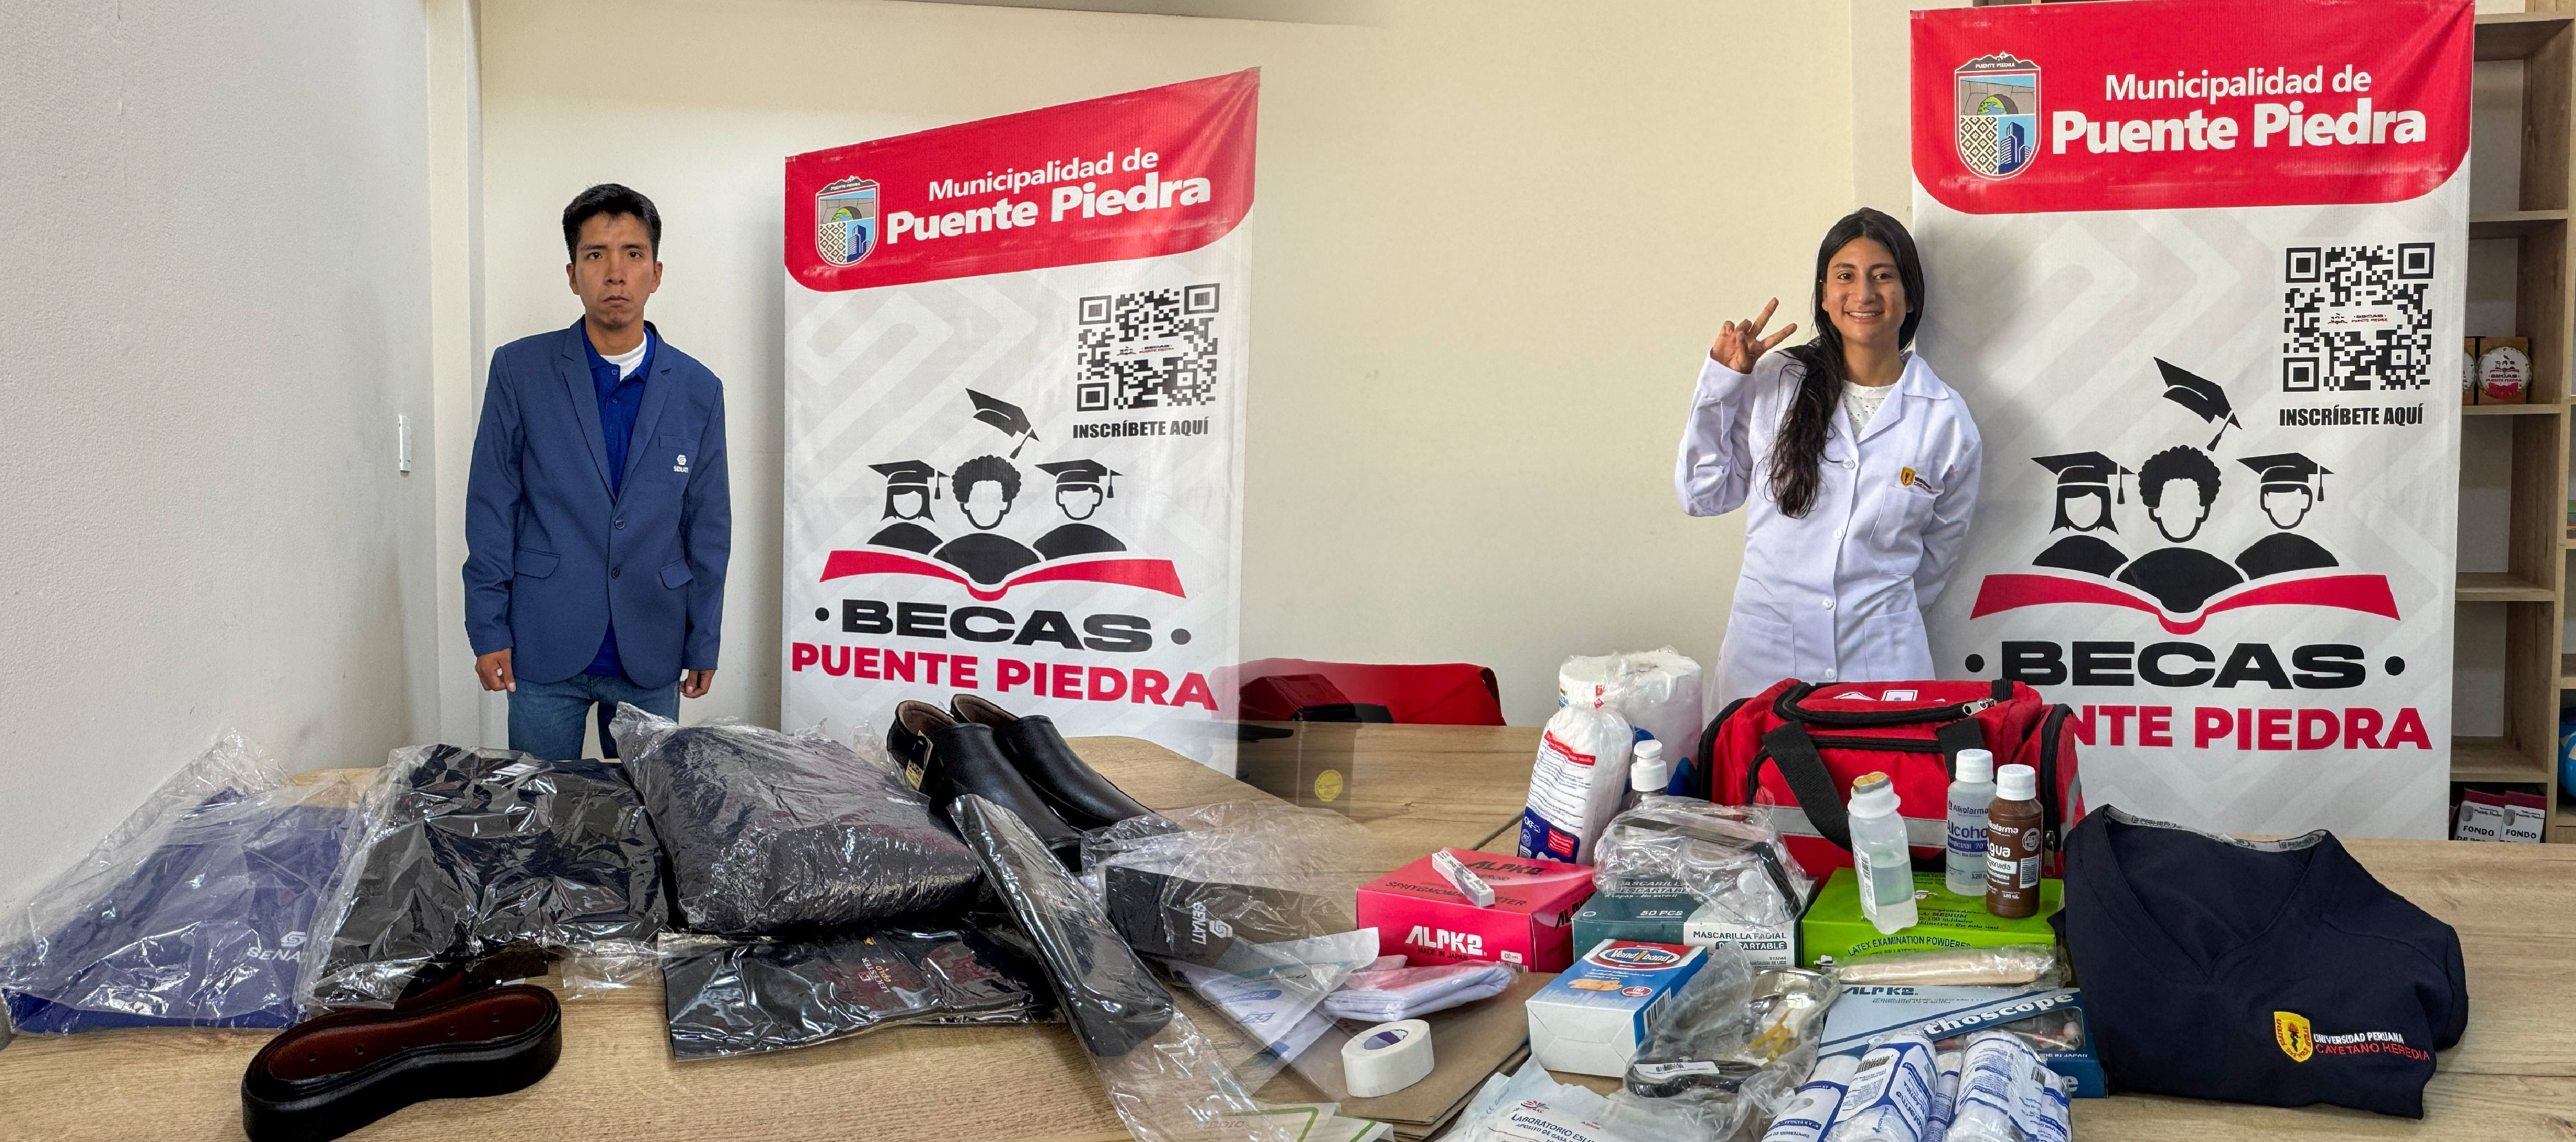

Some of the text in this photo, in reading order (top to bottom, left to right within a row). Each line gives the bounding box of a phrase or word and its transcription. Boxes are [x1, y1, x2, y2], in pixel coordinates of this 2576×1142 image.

[2107, 64, 2372, 105] Municipalidad de
[2052, 98, 2427, 155] Puente Piedra
[929, 148, 1159, 202] Municipalidad de
[887, 171, 1211, 244] Puente Piedra
[2279, 403, 2423, 426] INSCRÍBETE AQUÍ
[1073, 418, 1209, 439] INSCRÍBETE AQUÍ
[842, 599, 1153, 652] BECAS
[792, 642, 1219, 711] PUENTE PIEDRA
[2001, 641, 2366, 690] BECAS
[2074, 705, 2431, 750] NTE PIEDRA
[1947, 820, 1988, 839] Alcoho
[1988, 819, 2019, 833] lkofarma
[2463, 825, 2494, 836] FONDO
[2505, 828, 2537, 839] FONDO
[1191, 901, 1207, 945] SENATI
[1405, 925, 1484, 956] ALPK2
[1693, 931, 1752, 940] MASCARILLA
[1719, 942, 1785, 950] DCARTABLE
[1848, 942, 1870, 956] LATEX
[1872, 935, 1924, 948] EXAMINATION
[247, 946, 301, 963] SENA
[862, 957, 891, 993] LEICESTER
[875, 966, 891, 982] GOLD
[1842, 987, 1915, 996] ALPK2
[1922, 994, 2074, 1036] thoscope
[2313, 1032, 2405, 1044] UNIVERSIDAD PERUANA
[2315, 1043, 2430, 1061] CAYETANO HEREDIA
[1511, 1113, 1573, 1137] LABORATORIO
